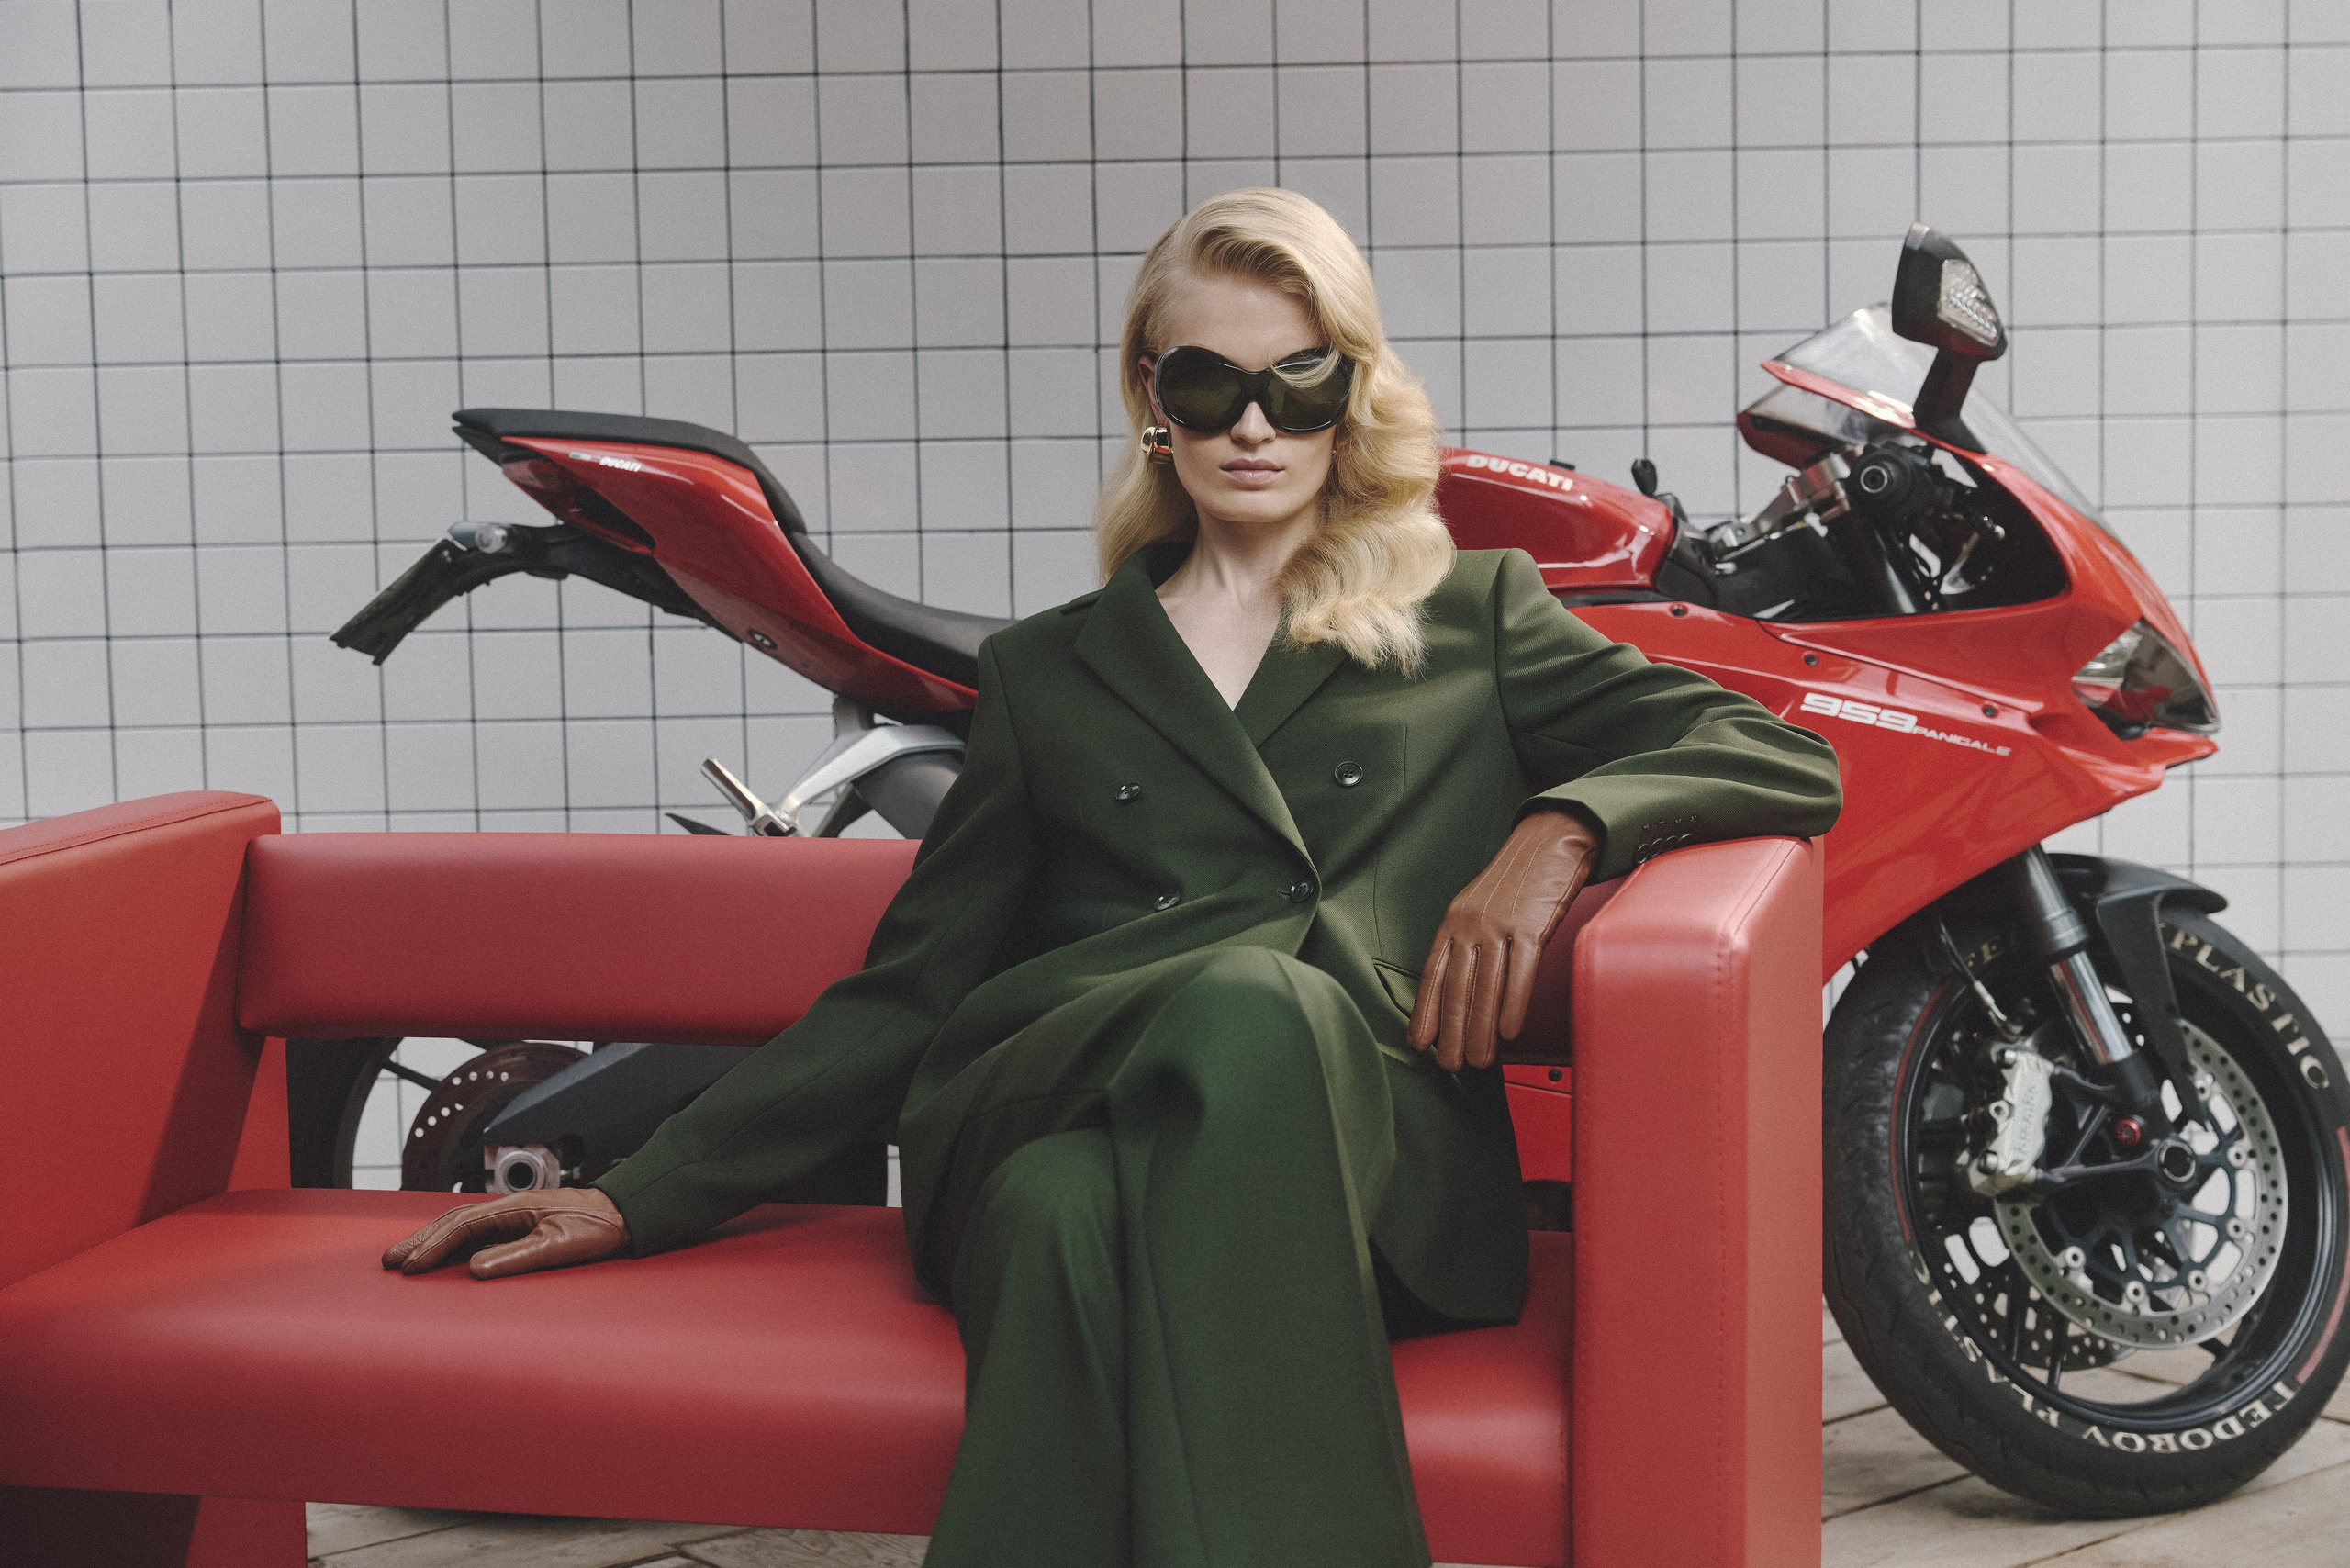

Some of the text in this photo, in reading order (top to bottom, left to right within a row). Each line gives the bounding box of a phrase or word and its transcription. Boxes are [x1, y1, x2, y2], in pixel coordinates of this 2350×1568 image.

[1466, 454, 1573, 491] DUCATI
[1800, 692, 2011, 756] 959 PANIGALE
[2170, 929, 2330, 1090] PLASTIC
